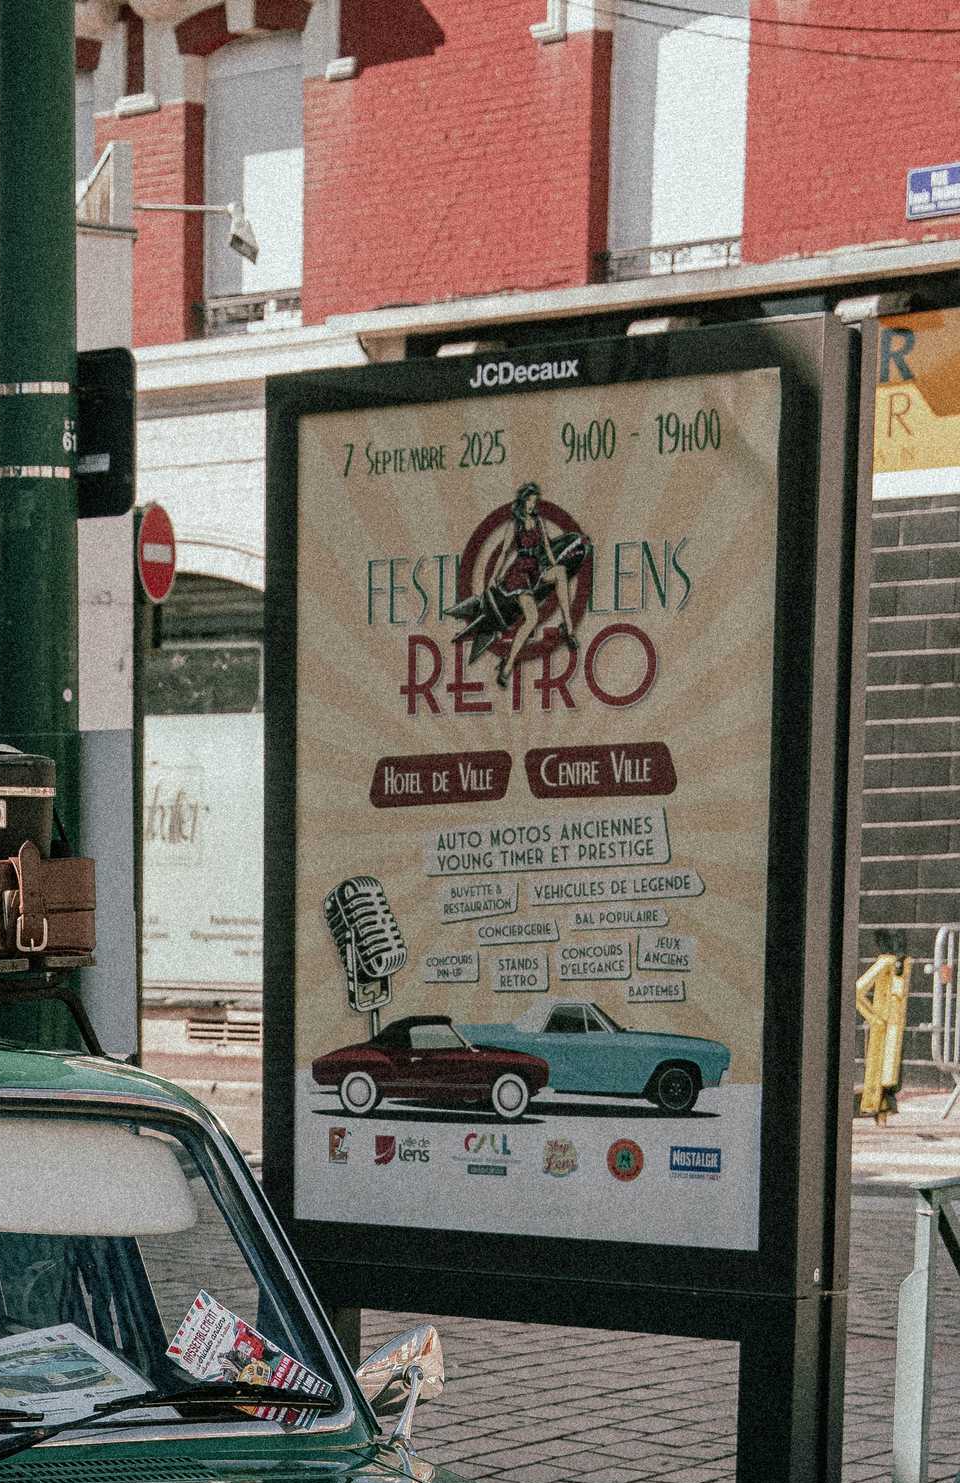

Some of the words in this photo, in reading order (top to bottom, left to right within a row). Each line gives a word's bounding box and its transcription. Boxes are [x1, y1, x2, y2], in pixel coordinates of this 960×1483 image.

[469, 358, 579, 389] JCDecaux
[343, 443, 354, 478] 7
[458, 429, 506, 468] 2025
[540, 753, 600, 787] CENTRE
[612, 750, 653, 784] VILLE
[437, 831, 482, 852] AUTO
[490, 826, 552, 848] MOTOS
[560, 816, 653, 843] ANCIENNES
[437, 852, 494, 872] YOUNG
[500, 847, 545, 868] TIMER
[551, 845, 570, 864] ET
[578, 838, 655, 862] PRESTIGE
[450, 886, 493, 899] BUVETTE
[534, 880, 606, 900] VEHICULES
[611, 877, 629, 893] DE
[634, 875, 691, 894] LEGENDE
[443, 897, 512, 916] RESTAURATION
[576, 914, 595, 925] BAL
[599, 910, 659, 925] POPULAIRE
[478, 922, 552, 939] CONCIERGERIE
[655, 936, 681, 951] JEUX
[426, 954, 473, 968] CONCOURS
[561, 944, 623, 961] CONCOURS
[644, 951, 689, 967] ANCIENS
[498, 958, 539, 972] STANDS
[561, 959, 625, 976] D'ELEGANCE
[500, 973, 538, 988] RETRO
[628, 983, 680, 998] BAPTEMES
[671, 1148, 719, 1168] NOSTALGIE
